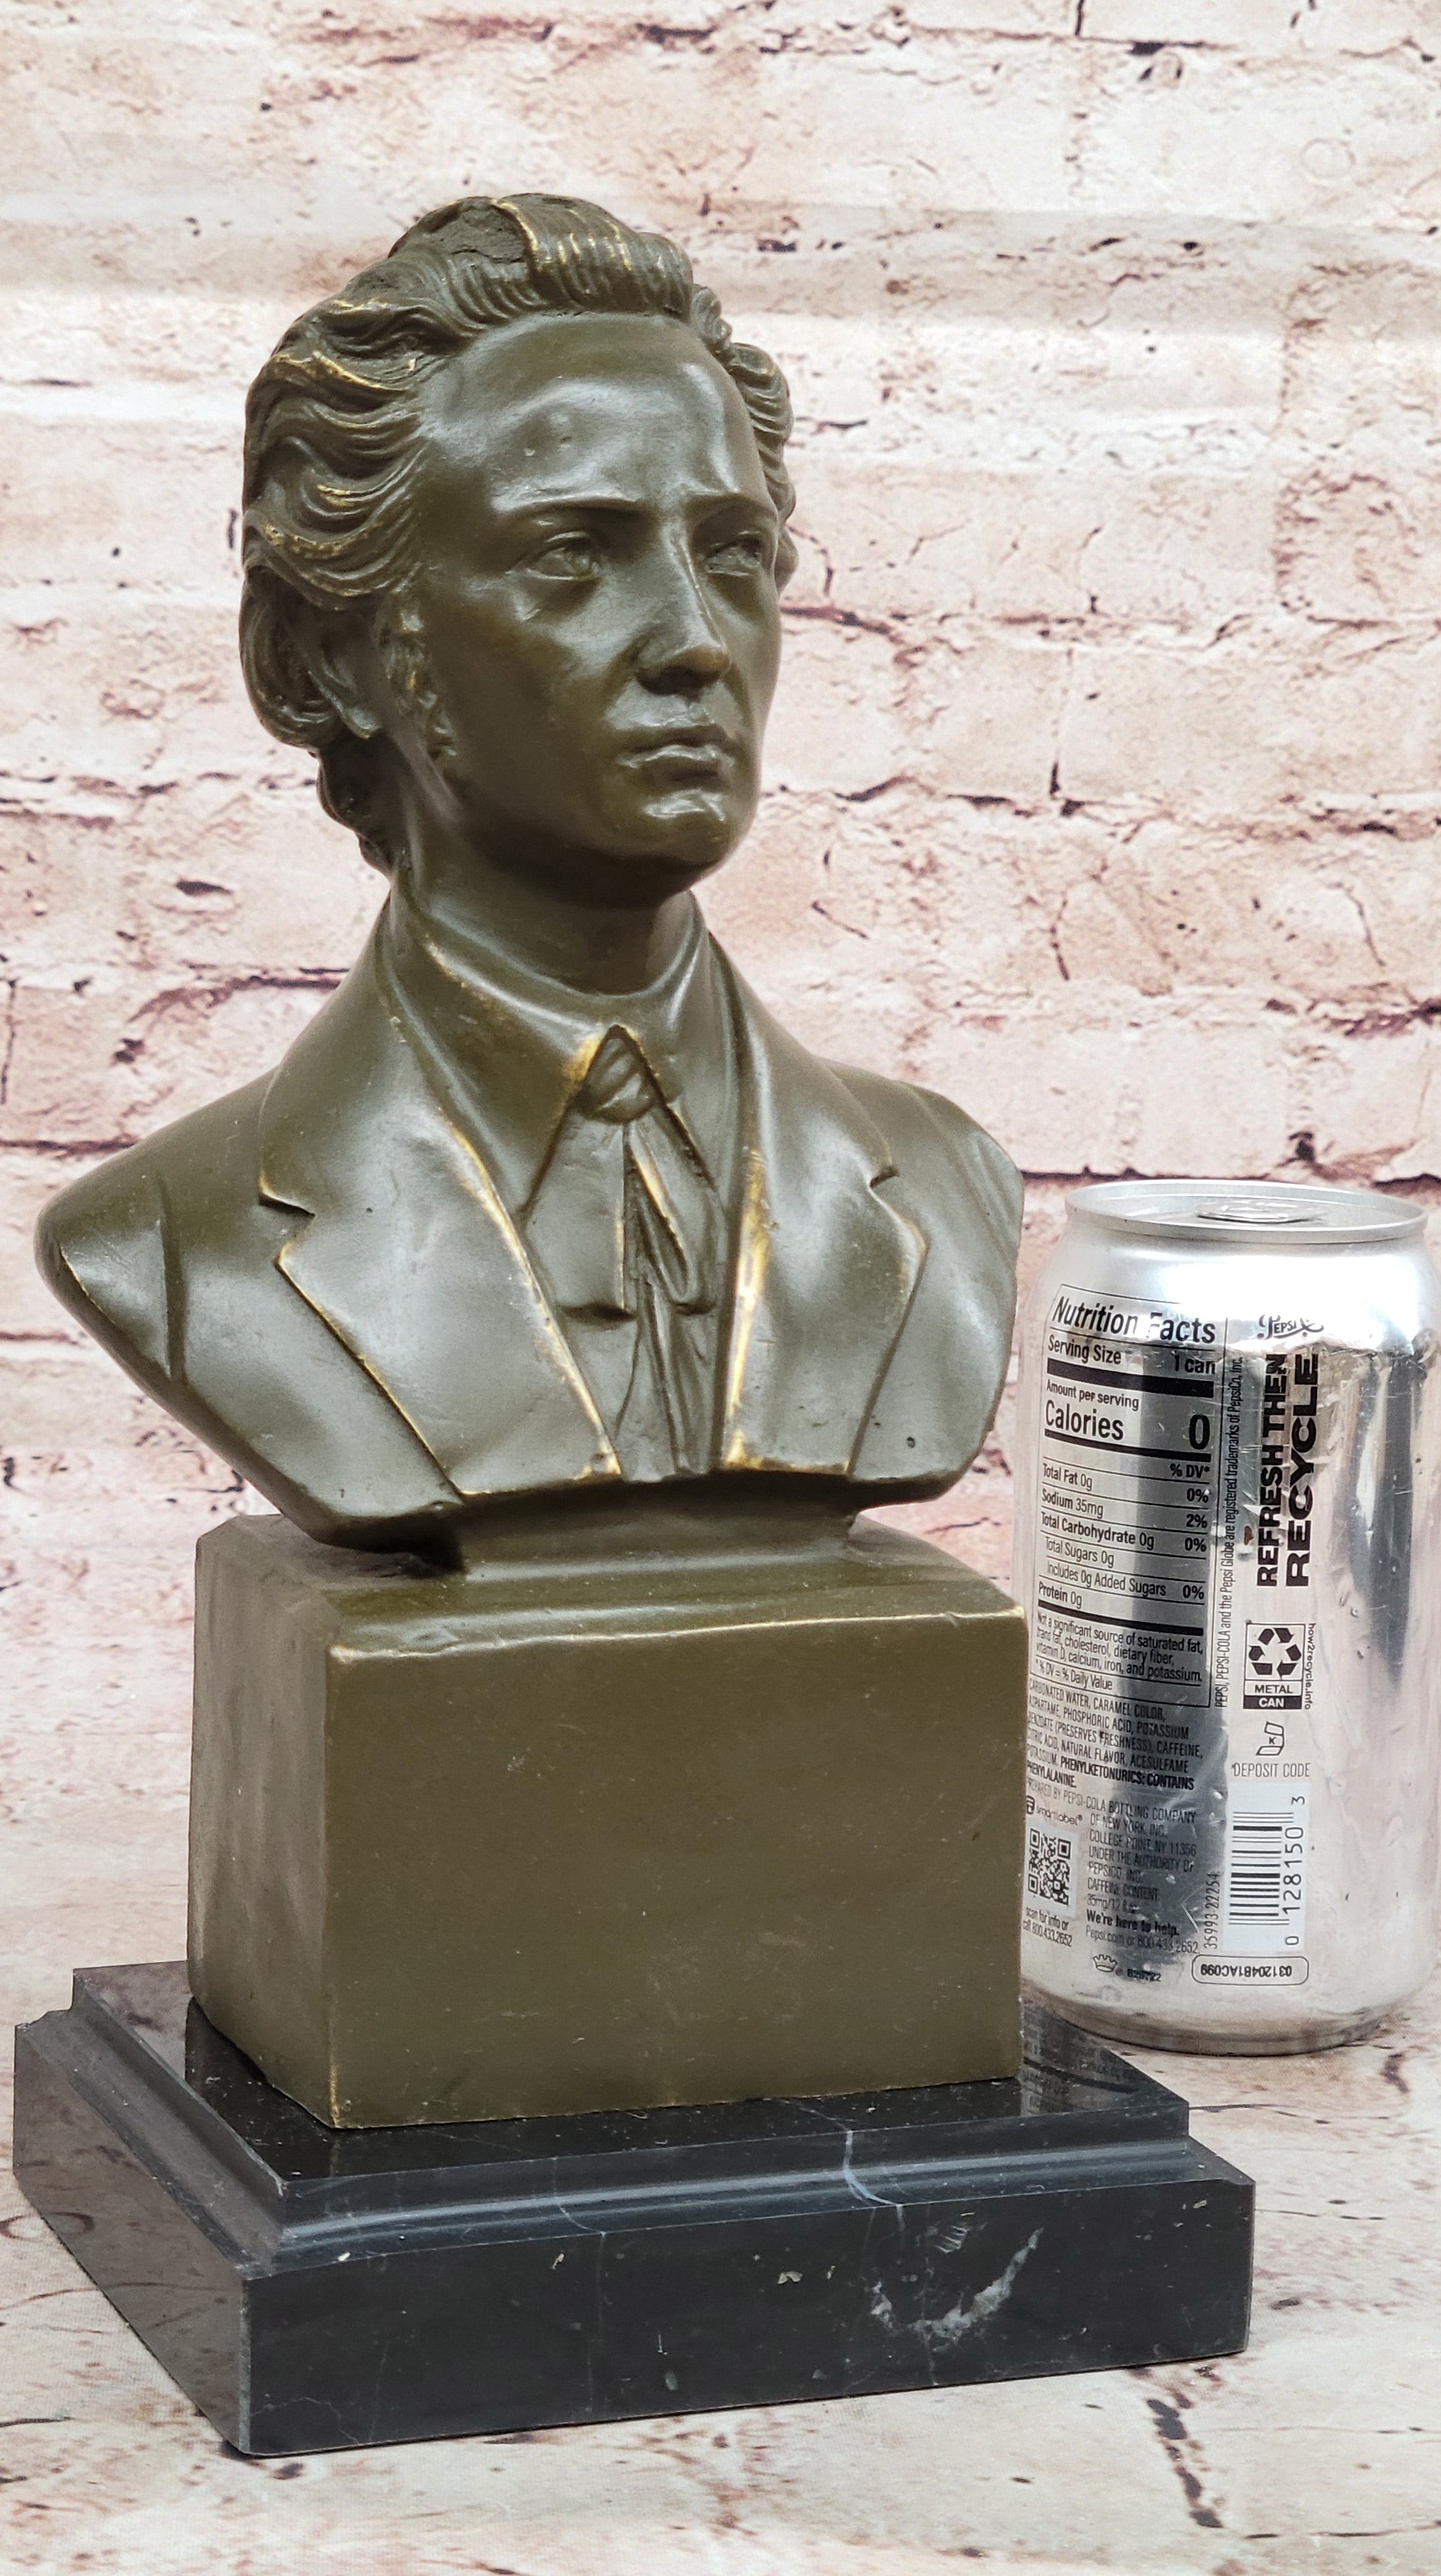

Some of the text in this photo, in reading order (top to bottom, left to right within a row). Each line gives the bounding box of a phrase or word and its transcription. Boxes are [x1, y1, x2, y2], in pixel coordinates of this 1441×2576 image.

[1052, 1296, 1216, 1344] Nutrition Facts
[1048, 1334, 1216, 1374] Serving Size 1 can
[1047, 1379, 1139, 1411] Amount per serving
[1046, 1400, 1210, 1450] Calories 0
[1043, 1463, 1208, 1503] Total Fat 0g 0%
[1170, 1464, 1182, 1477] %
[1256, 1354, 1288, 1587] REFRESH THEN
[1286, 1354, 1318, 1587] RECYCLE
[1042, 1489, 1207, 1529] Sodium 35mg 2%
[1041, 1512, 1207, 1552] Total Carbohydrate 0g 0%
[1215, 1358, 1243, 1708] PEPSI, PEPSI-COLA and the Pepsi Globe are registered trademarks of PepsiCo, Inc.
[1045, 1536, 1114, 1568] Total Sugars 0g
[1039, 1581, 1082, 1609] Protein 0g
[1047, 1561, 1204, 1599] Includes 0g Added Sugars 0%
[1048, 1618, 1052, 1627] a
[1054, 1617, 1092, 1638] significant
[1094, 1629, 1124, 1643] source
[1126, 1632, 1135, 1645] of
[1138, 1636, 1184, 1651] saturated
[1187, 1639, 1203, 1655] fat,
[1065, 1636, 1111, 1657] cholesterol,
[1114, 1644, 1147, 1663] dietary
[1150, 1649, 1174, 1666] fiber,
[1046, 1662, 1055, 1676] DV
[1071, 1669, 1089, 1689] Daily
[1090, 1674, 1113, 1690] Value
[1069, 1650, 1101, 1670] calcium,
[1104, 1656, 1124, 1674] iron,
[1126, 1662, 1144, 1675] and
[1148, 1666, 1202, 1682] potassium.
[1304, 1623, 1316, 1710] how2recycle.info
[1066, 1691, 1090, 1709] WATER,
[1094, 1697, 1131, 1716] CARAMEL
[1134, 1704, 1165, 1722] COLOR,
[1254, 1685, 1293, 1694] METAL
[1258, 1698, 1285, 1708] CAN
[1055, 1720, 1097, 1743] (PRESERVES
[1157, 1740, 1203, 1759] CAFFEINE,
[1064, 1706, 1109, 1729] PHOSPHORIC
[1112, 1717, 1133, 1735] ACID,
[1137, 1721, 1189, 1740] POTASSIUM
[1044, 1734, 1059, 1751] ACID,
[1062, 1740, 1092, 1759] NATURAL
[1094, 1747, 1127, 1767] FLAVOR,
[1130, 1754, 1189, 1773] ACESULFAME
[1269, 1736, 1276, 1745] K
[1061, 1756, 1145, 1784] PHENYLKETONURICS:
[1147, 1773, 1194, 1790] CONTAINS
[1283, 1763, 1310, 1777] CODE
[1053, 1787, 1061, 1799] BY
[1064, 1790, 1106, 1811] PEPSI-COLA
[1109, 1800, 1148, 1820] BOTTLING
[1153, 1807, 1196, 1824] COMPANY
[1090, 1813, 1100, 1826] OF
[1103, 1816, 1120, 1830] NEW
[1090, 1829, 1123, 1848] COLLEGE
[1089, 1845, 1114, 1862] UNDER
[1118, 1851, 1131, 1865] THE
[1134, 1853, 1180, 1871] AUTHORITY
[1282, 1795, 1306, 1945] 0 128150 3
[1088, 1877, 1121, 1896] CAFFEINE
[1086, 1909, 1179, 1938] We're here to help.
